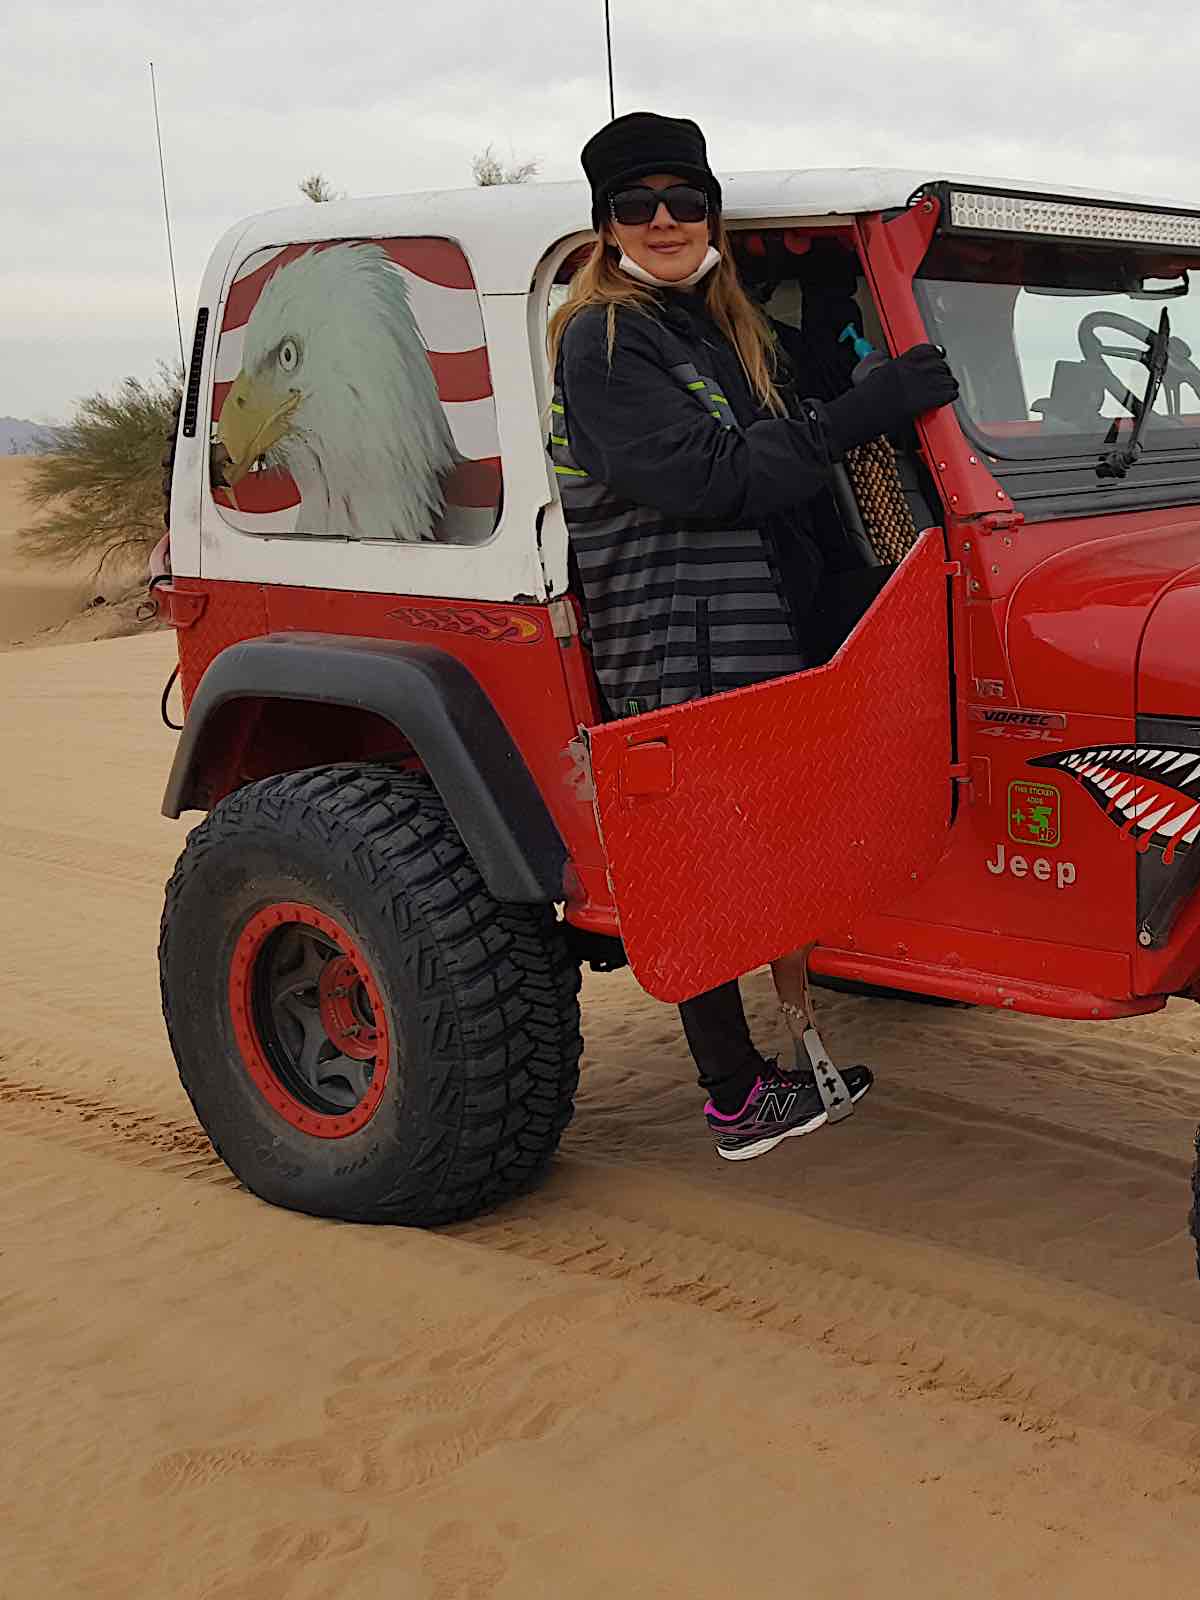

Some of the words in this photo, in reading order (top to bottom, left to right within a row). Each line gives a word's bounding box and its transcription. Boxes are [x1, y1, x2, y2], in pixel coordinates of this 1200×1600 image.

[983, 711, 1050, 727] VORTEC
[977, 726, 1064, 743] 4.3L
[986, 844, 1077, 888] Jeep
[755, 1092, 797, 1122] N
